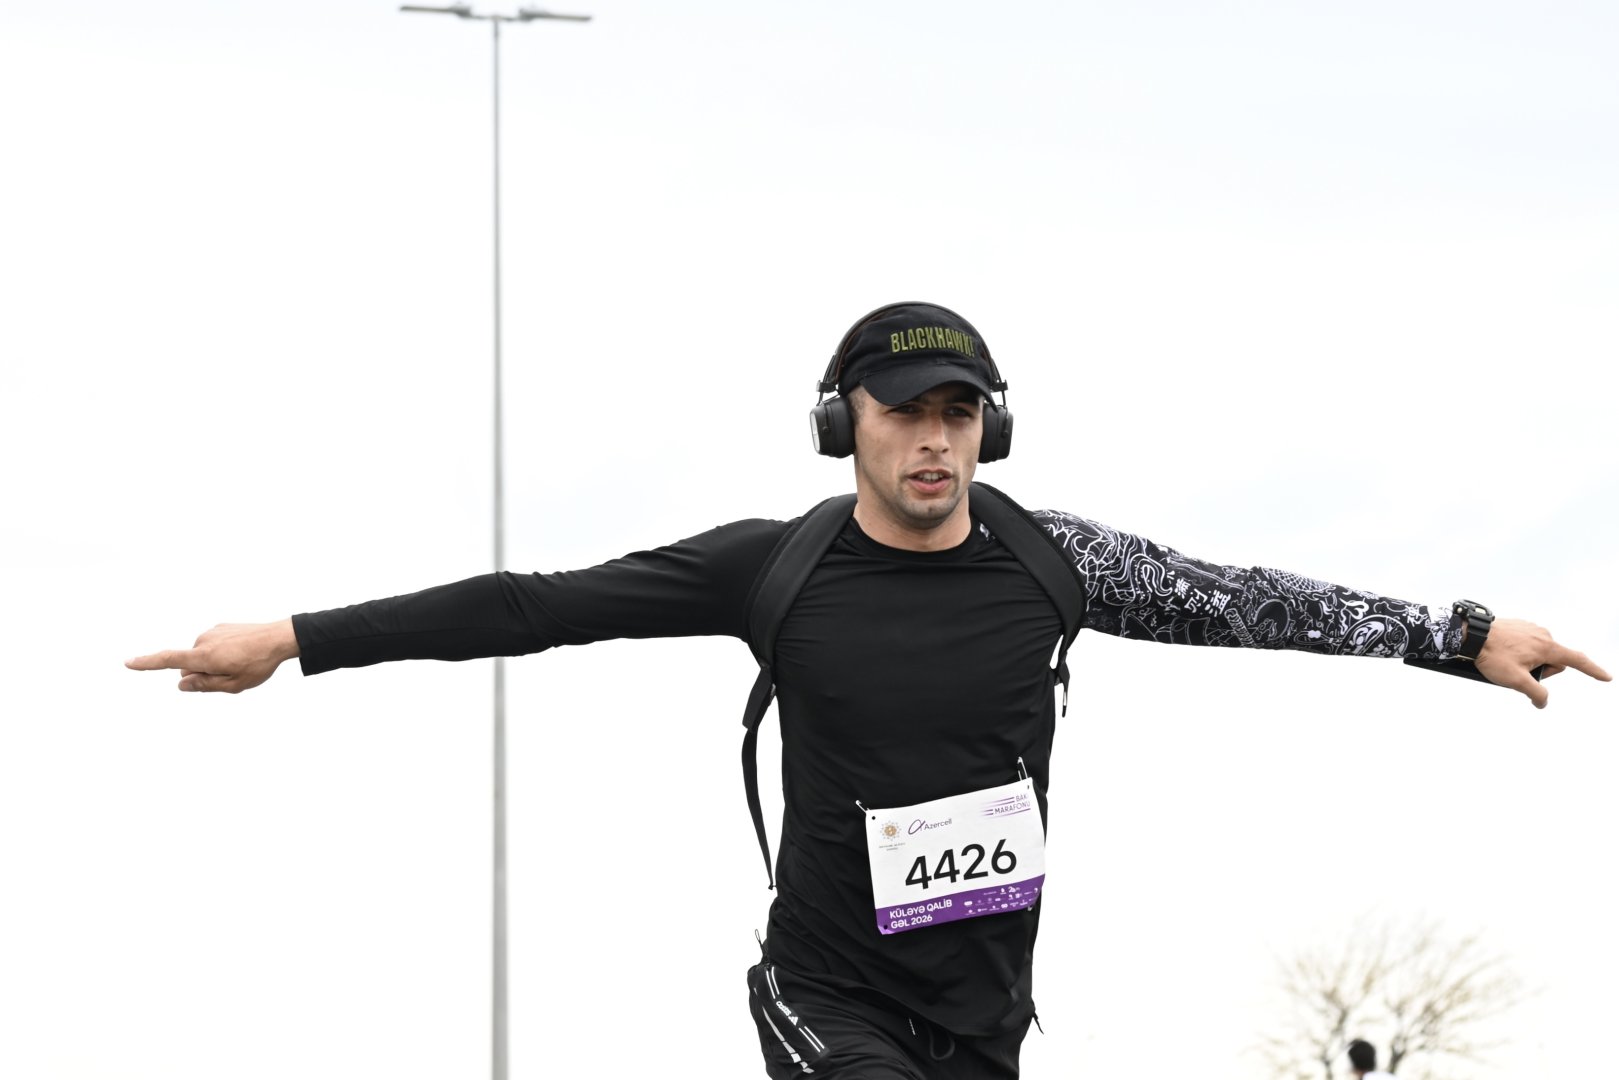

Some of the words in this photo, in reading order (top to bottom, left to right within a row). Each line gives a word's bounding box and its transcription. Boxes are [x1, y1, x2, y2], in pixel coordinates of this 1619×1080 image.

[890, 326, 975, 358] BLACKHAWK!
[1015, 793, 1029, 802] BAK
[994, 801, 1031, 814] MARAFONU
[923, 818, 953, 831] Azercell
[905, 839, 1017, 890] 4426
[889, 906, 926, 919] KÜLƏYƏ
[926, 899, 953, 912] QALİB
[890, 919, 910, 929] GƏL
[911, 914, 933, 926] 2026
